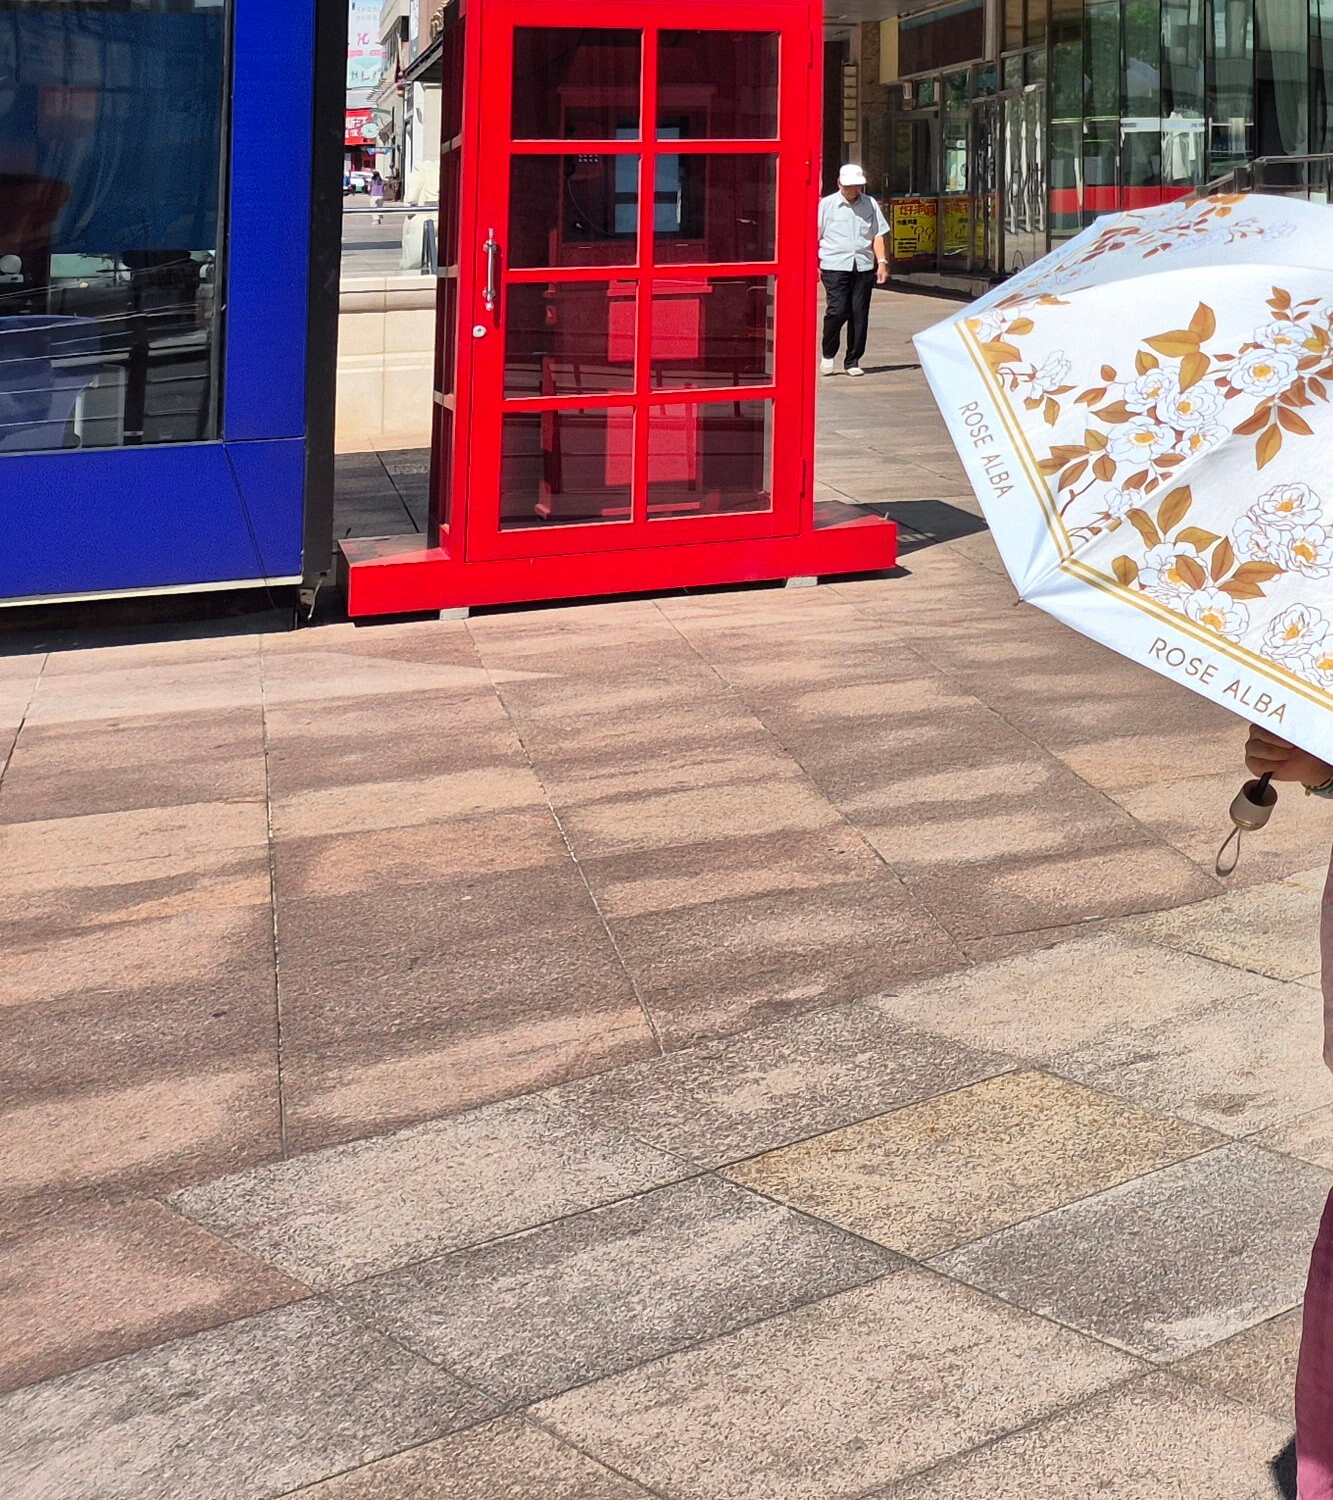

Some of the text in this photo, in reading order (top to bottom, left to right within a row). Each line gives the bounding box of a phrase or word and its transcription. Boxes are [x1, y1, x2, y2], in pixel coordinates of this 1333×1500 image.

[958, 401, 1014, 498] ROSE ALBA
[1148, 637, 1287, 724] ROSE ALBA
